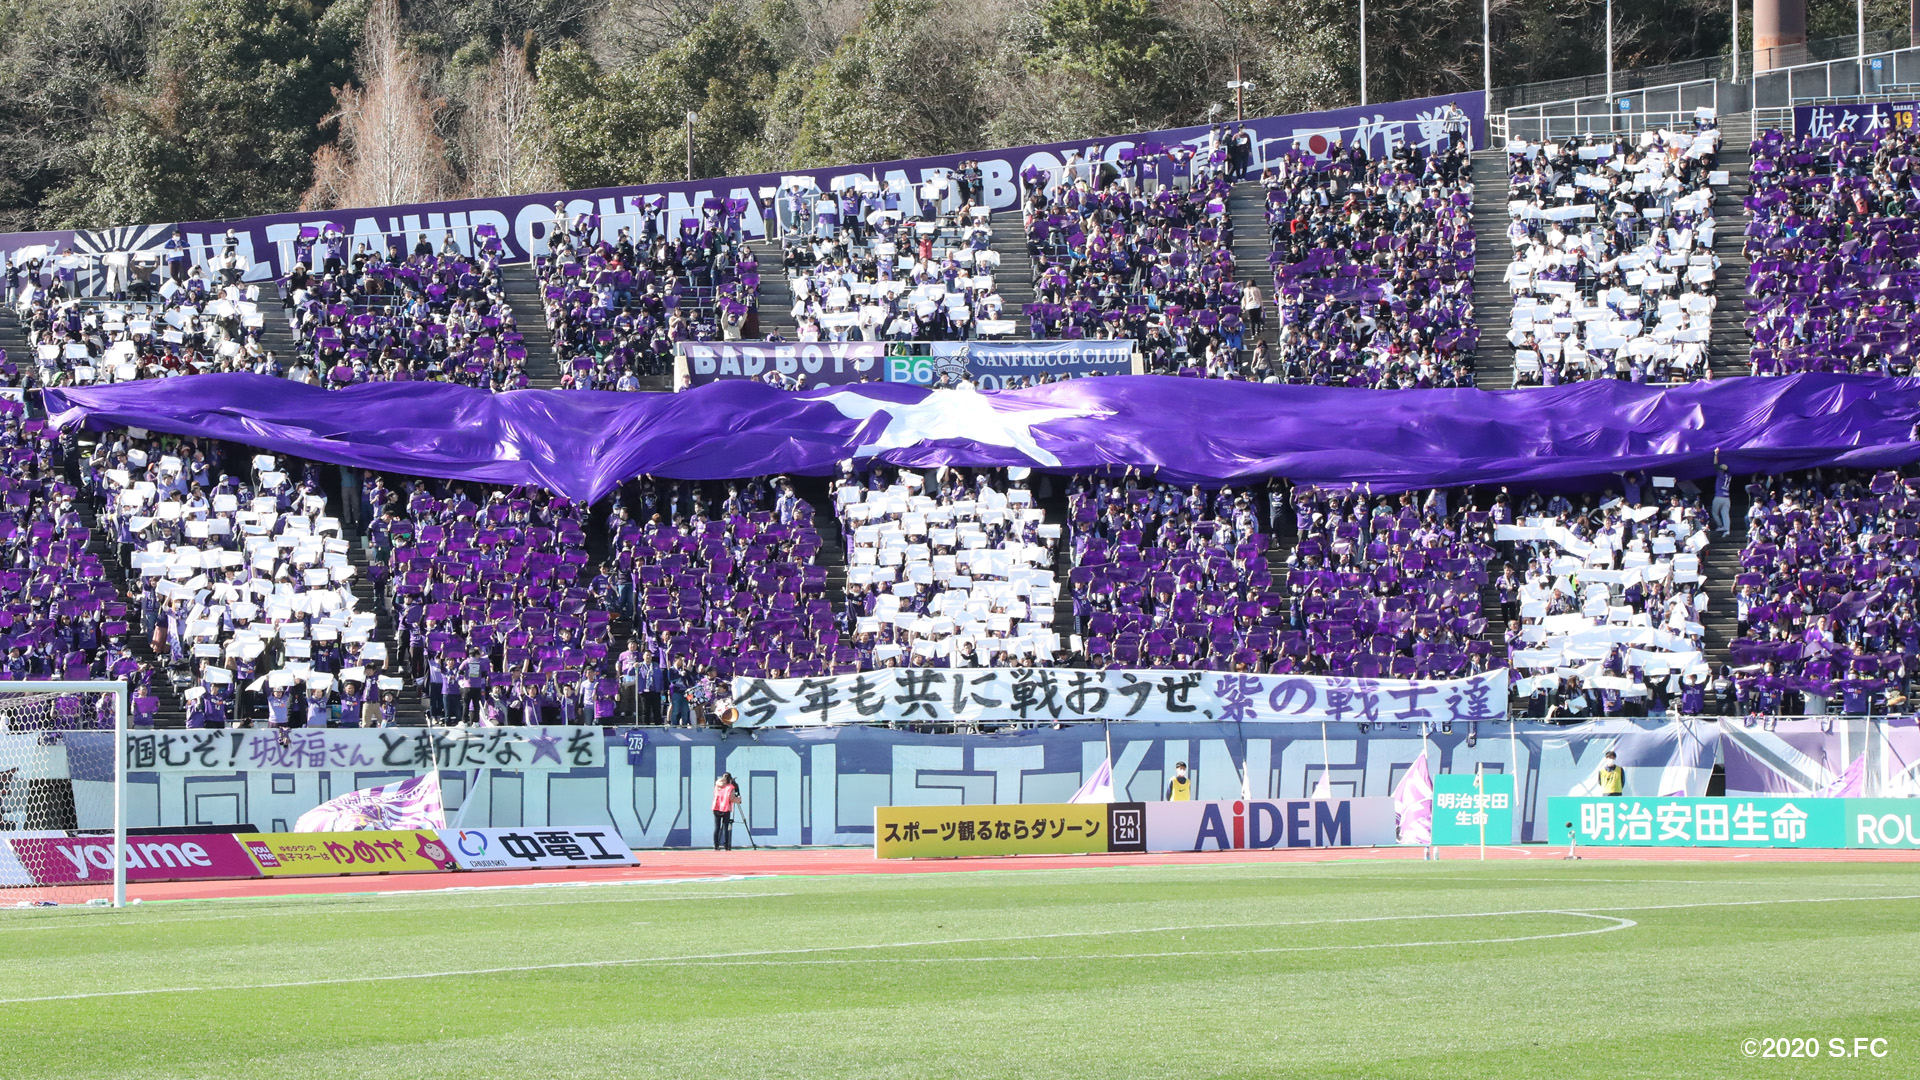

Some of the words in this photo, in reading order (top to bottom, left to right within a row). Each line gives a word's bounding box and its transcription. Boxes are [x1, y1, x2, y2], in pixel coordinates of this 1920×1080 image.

[1872, 59, 1882, 69] 68
[1620, 100, 1630, 109] 69
[1809, 103, 1888, 138] 佐々木
[1894, 111, 1914, 129] 19
[692, 345, 766, 376] BAD
[774, 343, 876, 375] BOYS
[976, 348, 1080, 367] SANFRECCE
[1082, 347, 1130, 365] CLUB
[890, 359, 933, 384] B6
[628, 737, 644, 750] 273
[1437, 793, 1509, 810] 明治安田
[1119, 815, 1135, 827] DA
[1194, 800, 1351, 852] AiDEM
[1455, 811, 1489, 826] 生命
[1580, 801, 1809, 843] 明治安田生命
[884, 818, 1101, 843] スポーツ観るならダゾーン
[1119, 828, 1135, 839] ZN
[249, 846, 270, 856] you
[498, 831, 626, 862] 中電工
[55, 842, 212, 879] youme
[259, 853, 276, 861] me
[469, 859, 508, 868] CHUDENKO
